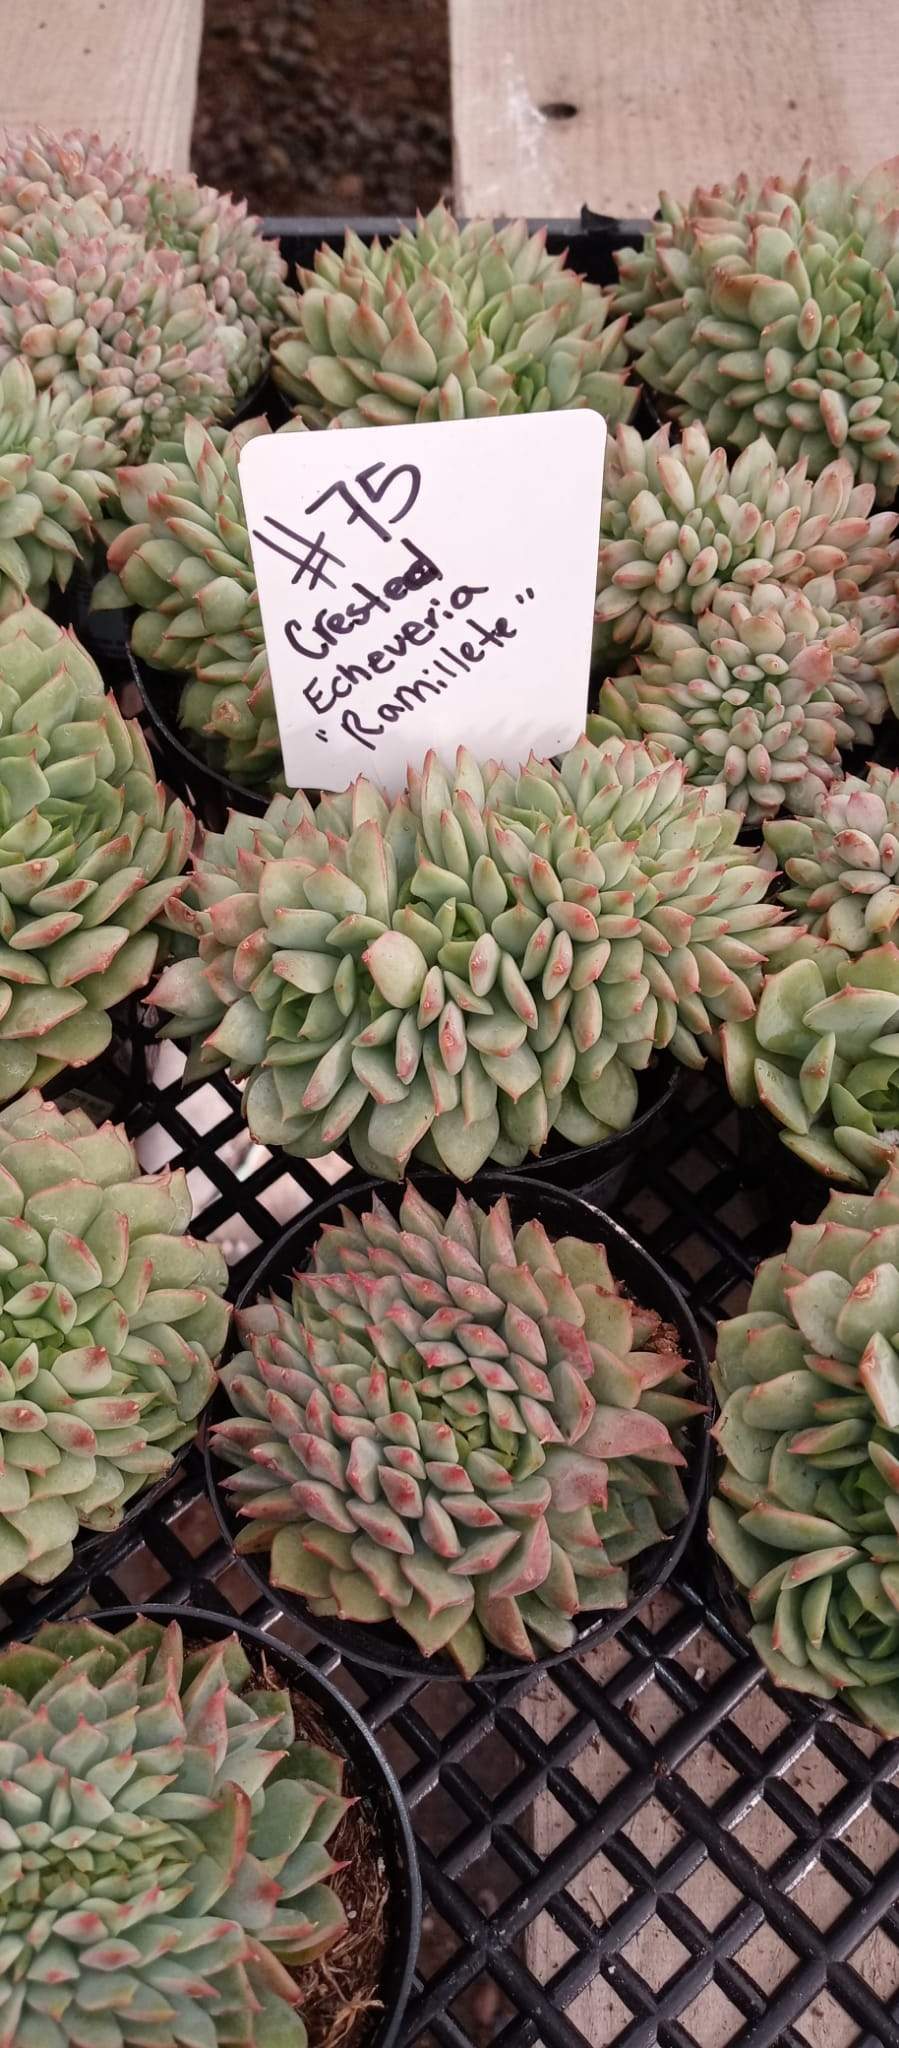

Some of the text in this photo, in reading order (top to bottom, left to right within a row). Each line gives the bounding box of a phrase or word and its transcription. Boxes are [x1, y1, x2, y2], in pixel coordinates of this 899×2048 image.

[252, 462, 422, 590] #75
[283, 537, 443, 660] Crested
[302, 585, 489, 714] Echeveria
